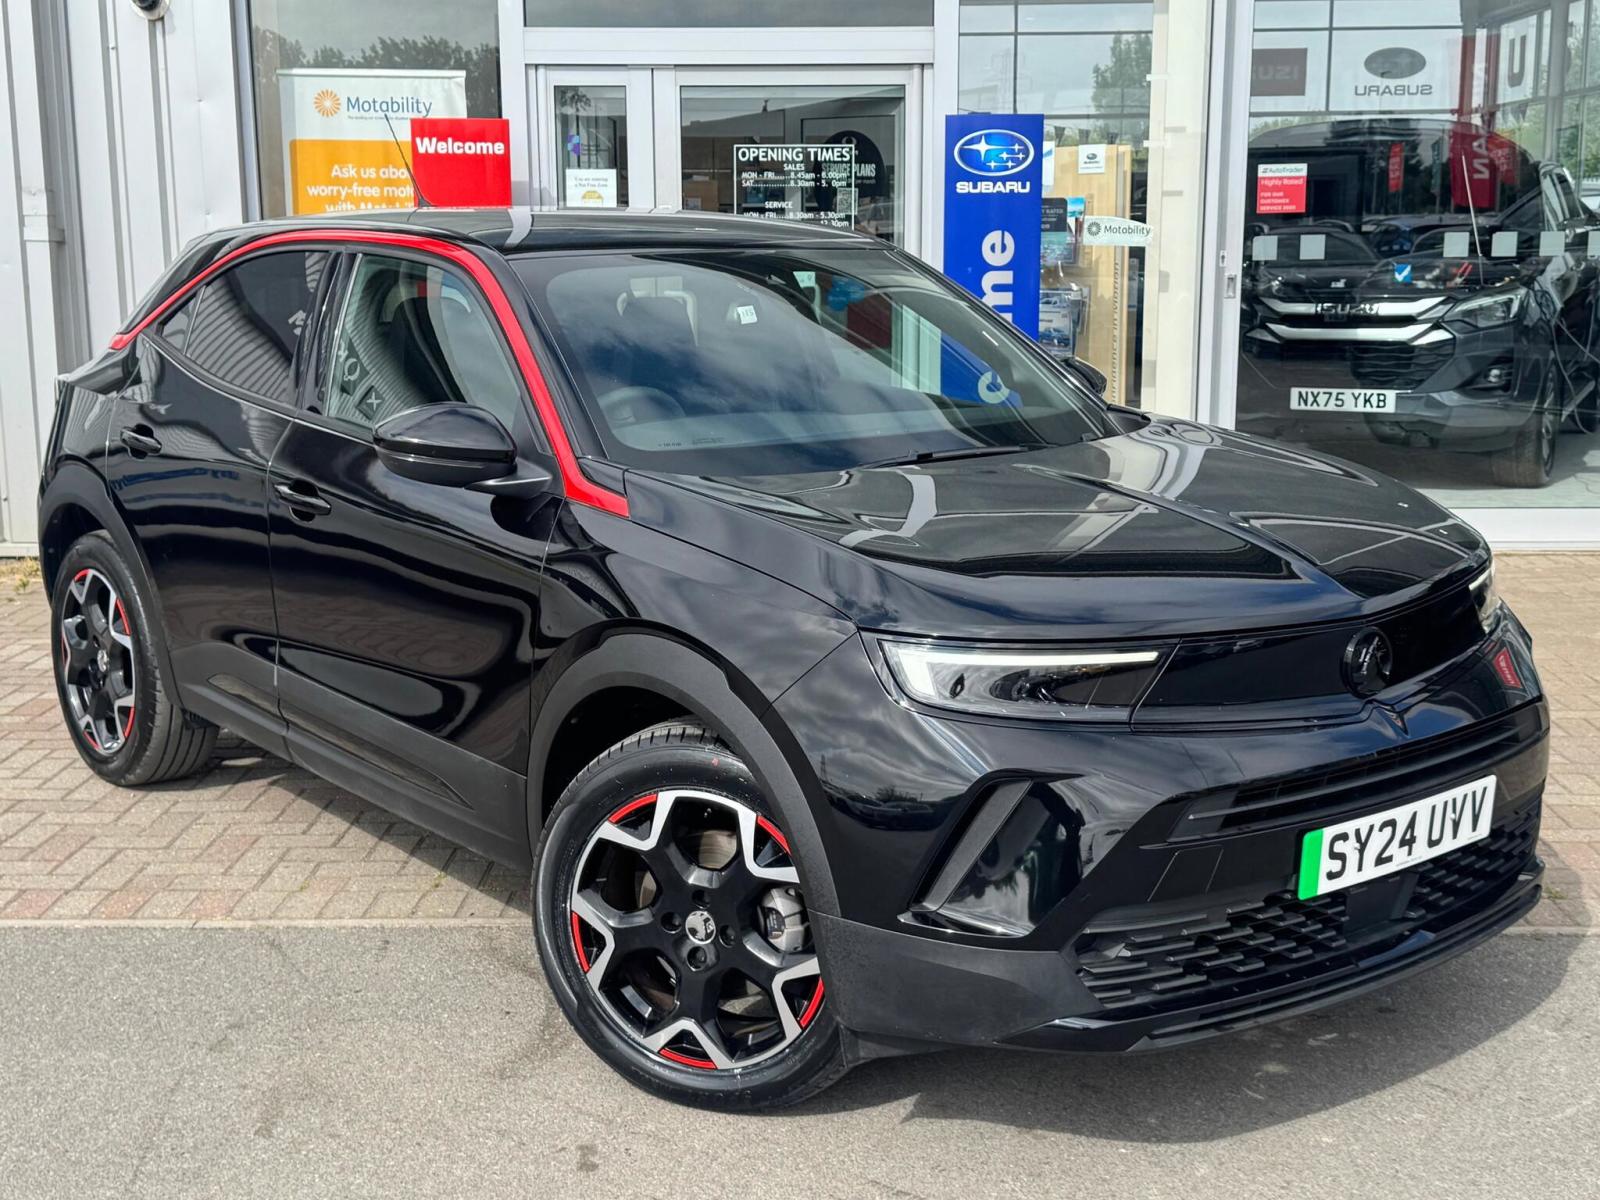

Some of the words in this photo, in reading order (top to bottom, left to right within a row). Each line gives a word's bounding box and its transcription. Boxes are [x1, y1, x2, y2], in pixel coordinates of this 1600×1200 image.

[346, 96, 433, 119] Motability
[415, 137, 505, 155] Welcome
[738, 147, 804, 162] OPENING
[807, 147, 851, 162] TIMES
[331, 164, 358, 179] Ask
[360, 167, 376, 179] us
[379, 164, 410, 179] abo
[783, 163, 805, 171] SALES
[854, 163, 876, 177] PLANS
[306, 183, 381, 200] worry-free
[955, 181, 1031, 194] SUBARU
[764, 201, 793, 209] SERVICE
[1103, 223, 1151, 238] Motability
[1297, 390, 1345, 409] NX75
[1351, 391, 1388, 410] YKB
[1325, 810, 1418, 881] SY24
[1426, 786, 1488, 849] UVV
